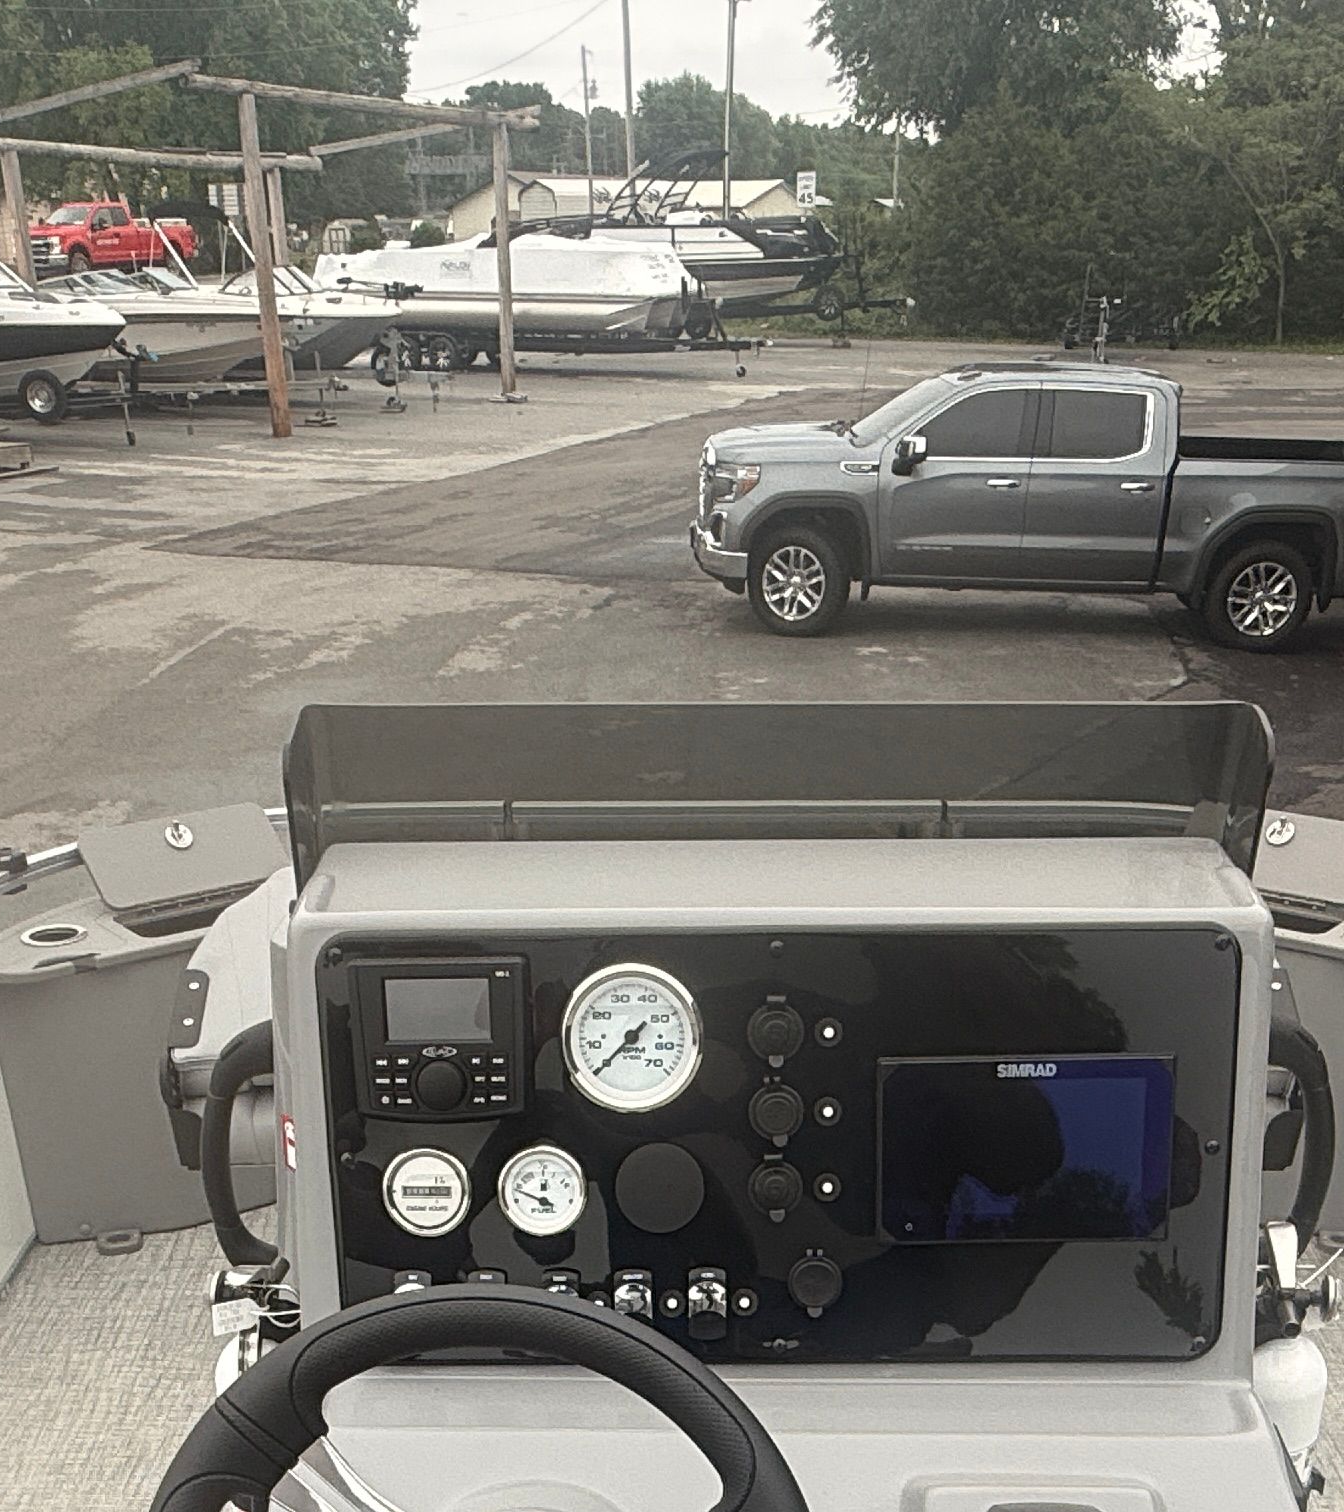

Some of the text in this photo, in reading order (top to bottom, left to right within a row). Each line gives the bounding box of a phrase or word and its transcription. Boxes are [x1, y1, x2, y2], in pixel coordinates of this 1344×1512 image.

[799, 193, 814, 204] 45
[611, 994, 630, 1003] 30
[637, 994, 657, 1003] 40
[592, 1011, 612, 1020] 20
[586, 1040, 602, 1049] 10
[655, 1042, 675, 1050] 60
[644, 1059, 664, 1068] 70
[997, 1063, 1057, 1078] SIMRAD
